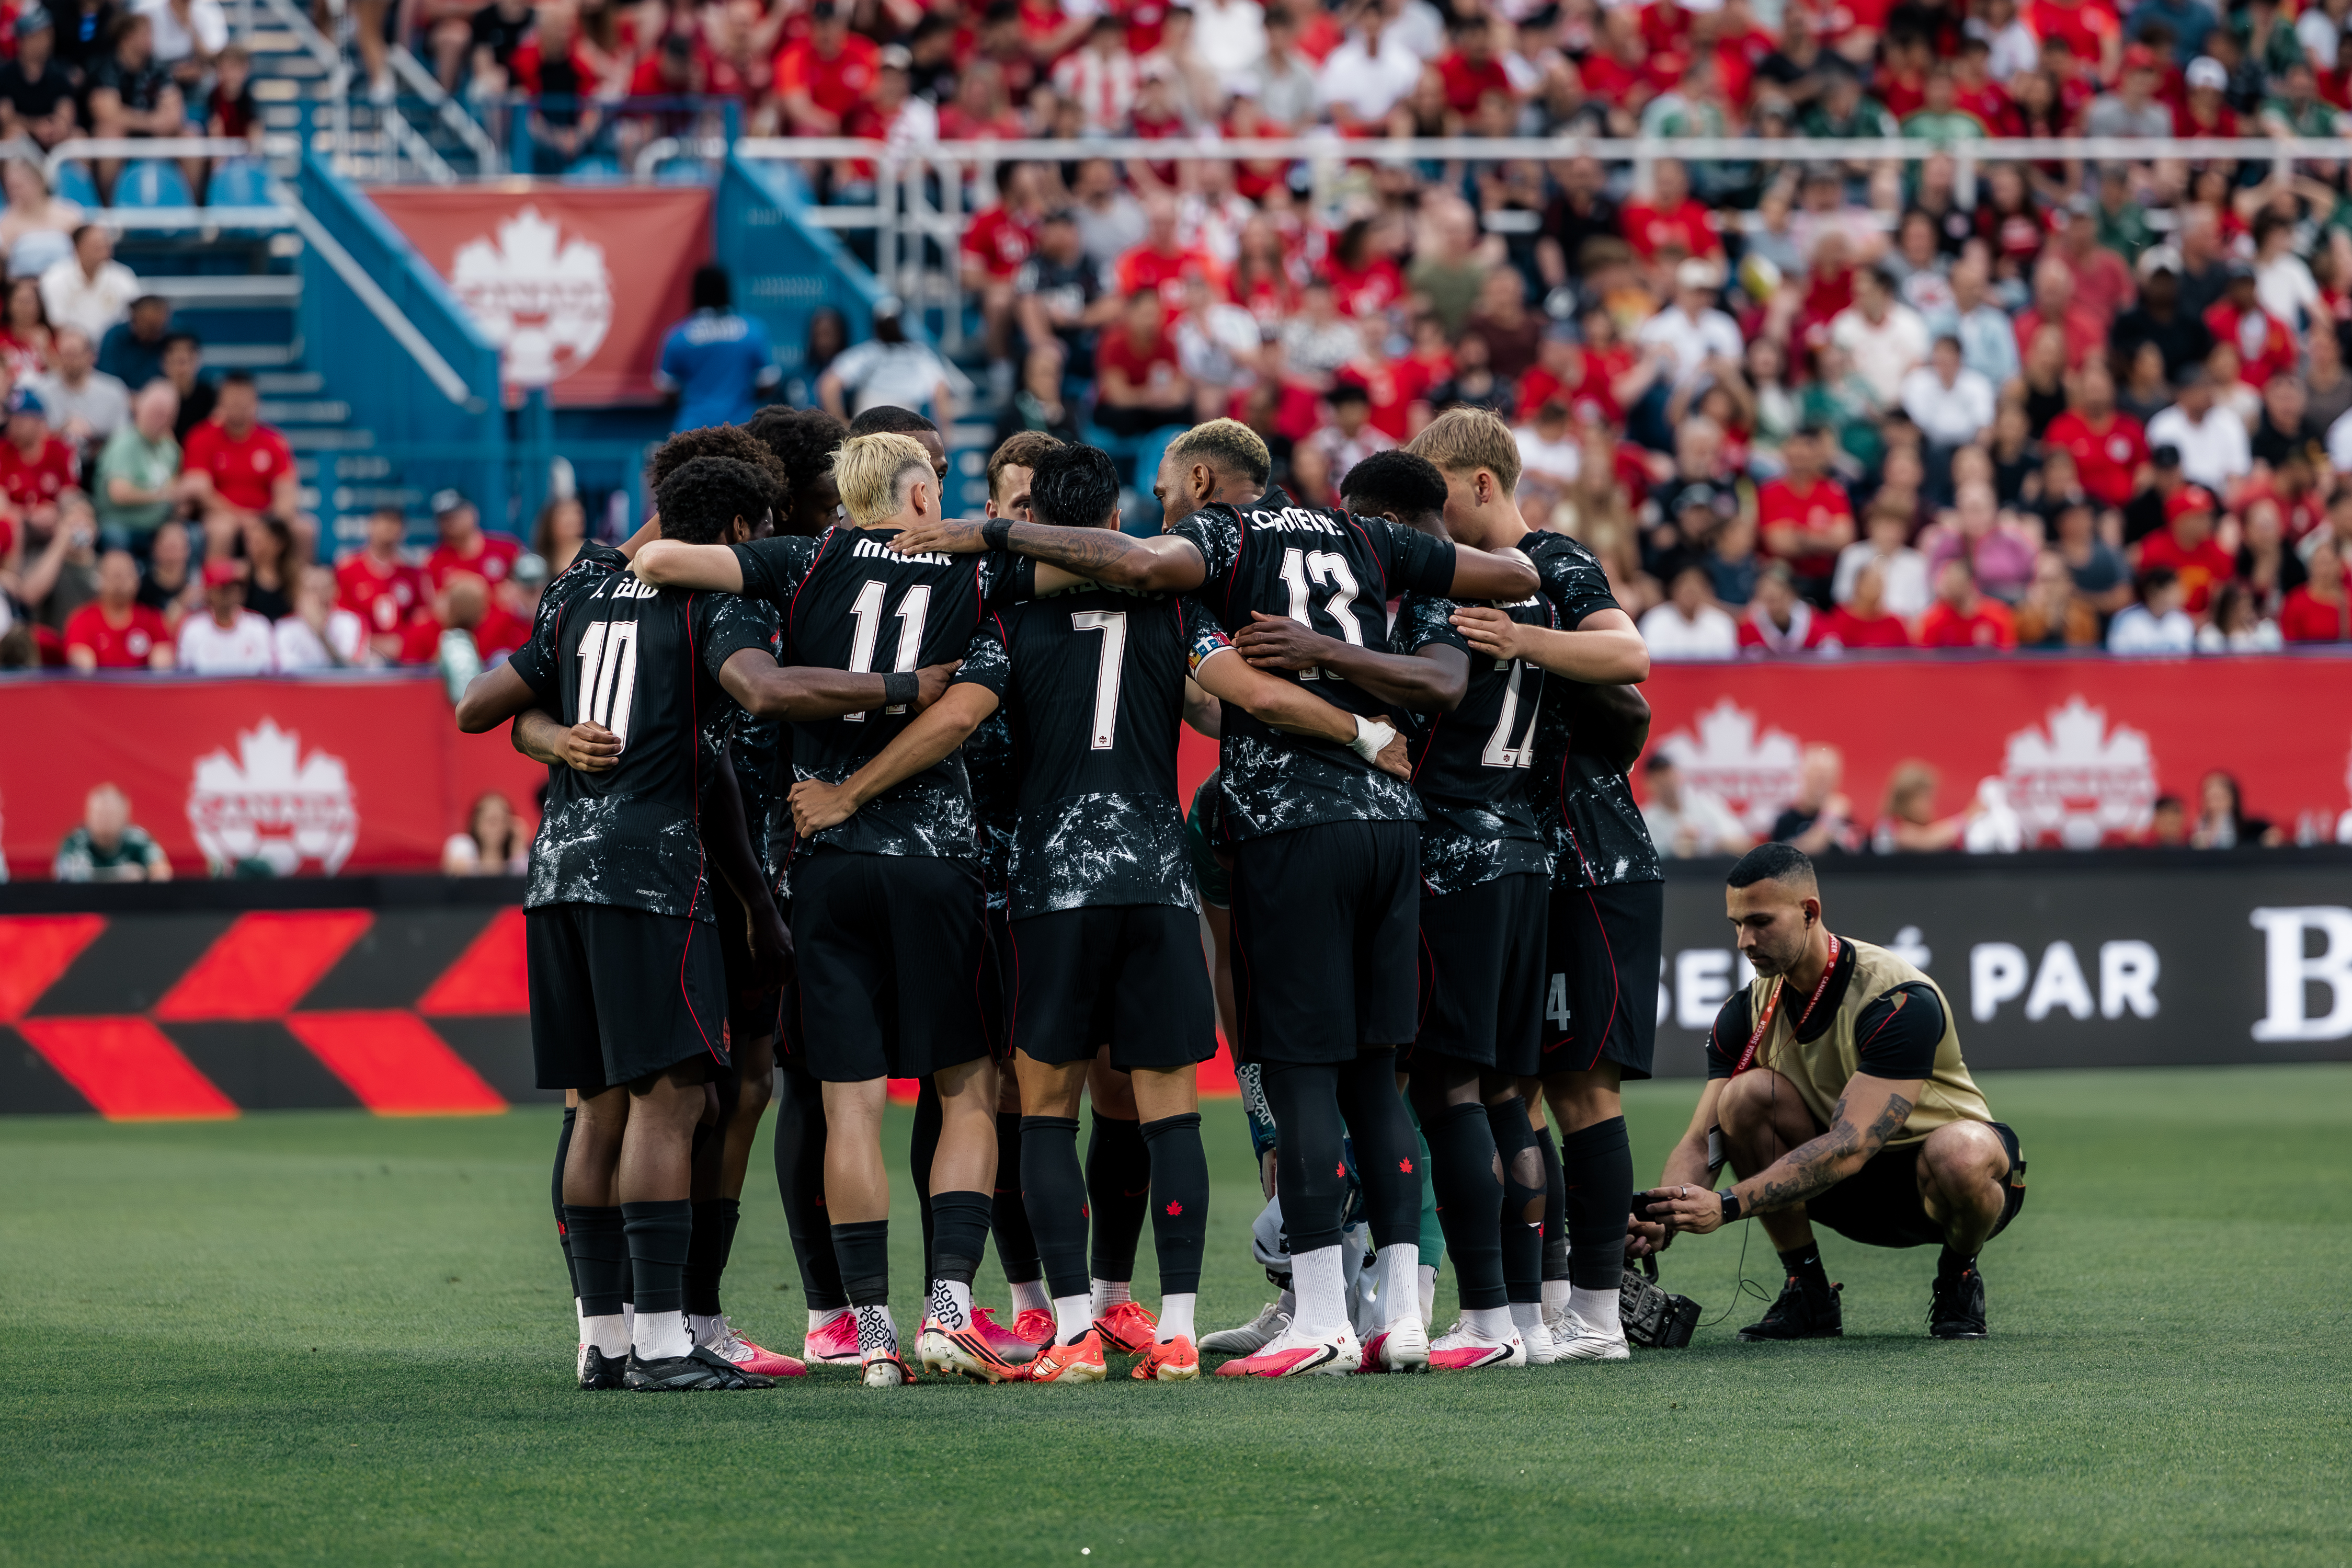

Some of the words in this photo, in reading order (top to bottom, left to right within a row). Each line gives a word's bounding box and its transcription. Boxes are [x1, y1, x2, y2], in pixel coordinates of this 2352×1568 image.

[843, 579, 931, 722] 11
[1071, 610, 1127, 750] 7
[1279, 547, 1364, 680] 13
[577, 620, 638, 757] 10
[1546, 972, 1571, 1031] 4
[1812, 976, 1829, 1004] CANADA
[1969, 940, 2161, 1023] PAR
[2250, 906, 2352, 1043] B
[1738, 1045, 1755, 1070] CANADA
[1751, 1020, 1767, 1045] SOCCER
